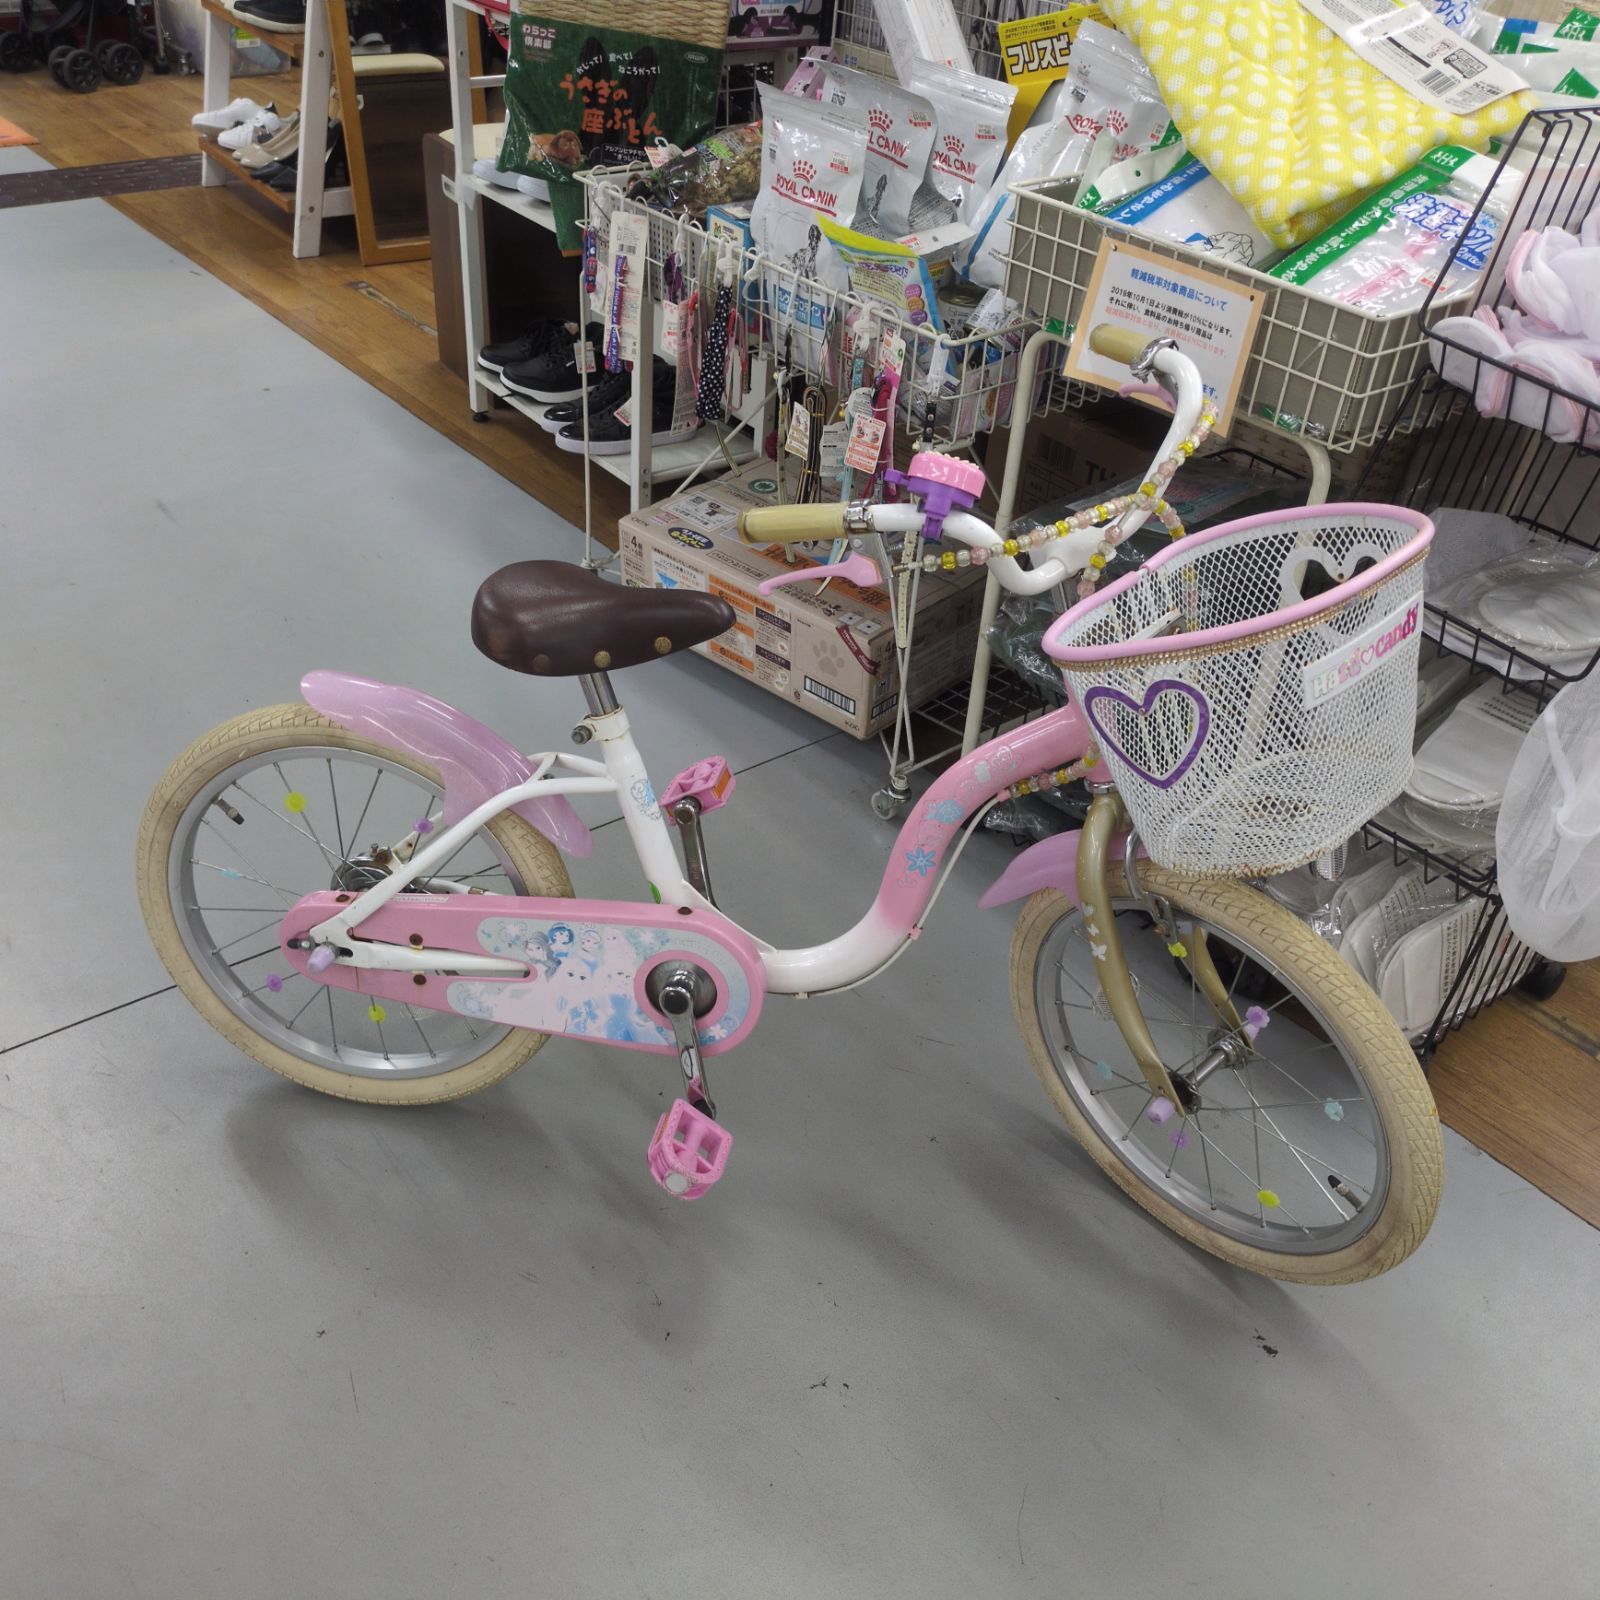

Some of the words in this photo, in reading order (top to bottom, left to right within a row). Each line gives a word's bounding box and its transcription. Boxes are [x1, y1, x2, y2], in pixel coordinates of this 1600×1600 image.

[1005, 32, 1073, 76] フリスビ
[559, 72, 628, 103] うさぎの
[581, 107, 662, 144] 座ぶとん
[800, 185, 838, 208] CANIN
[1130, 267, 1229, 312] 軽減税率対象商品について
